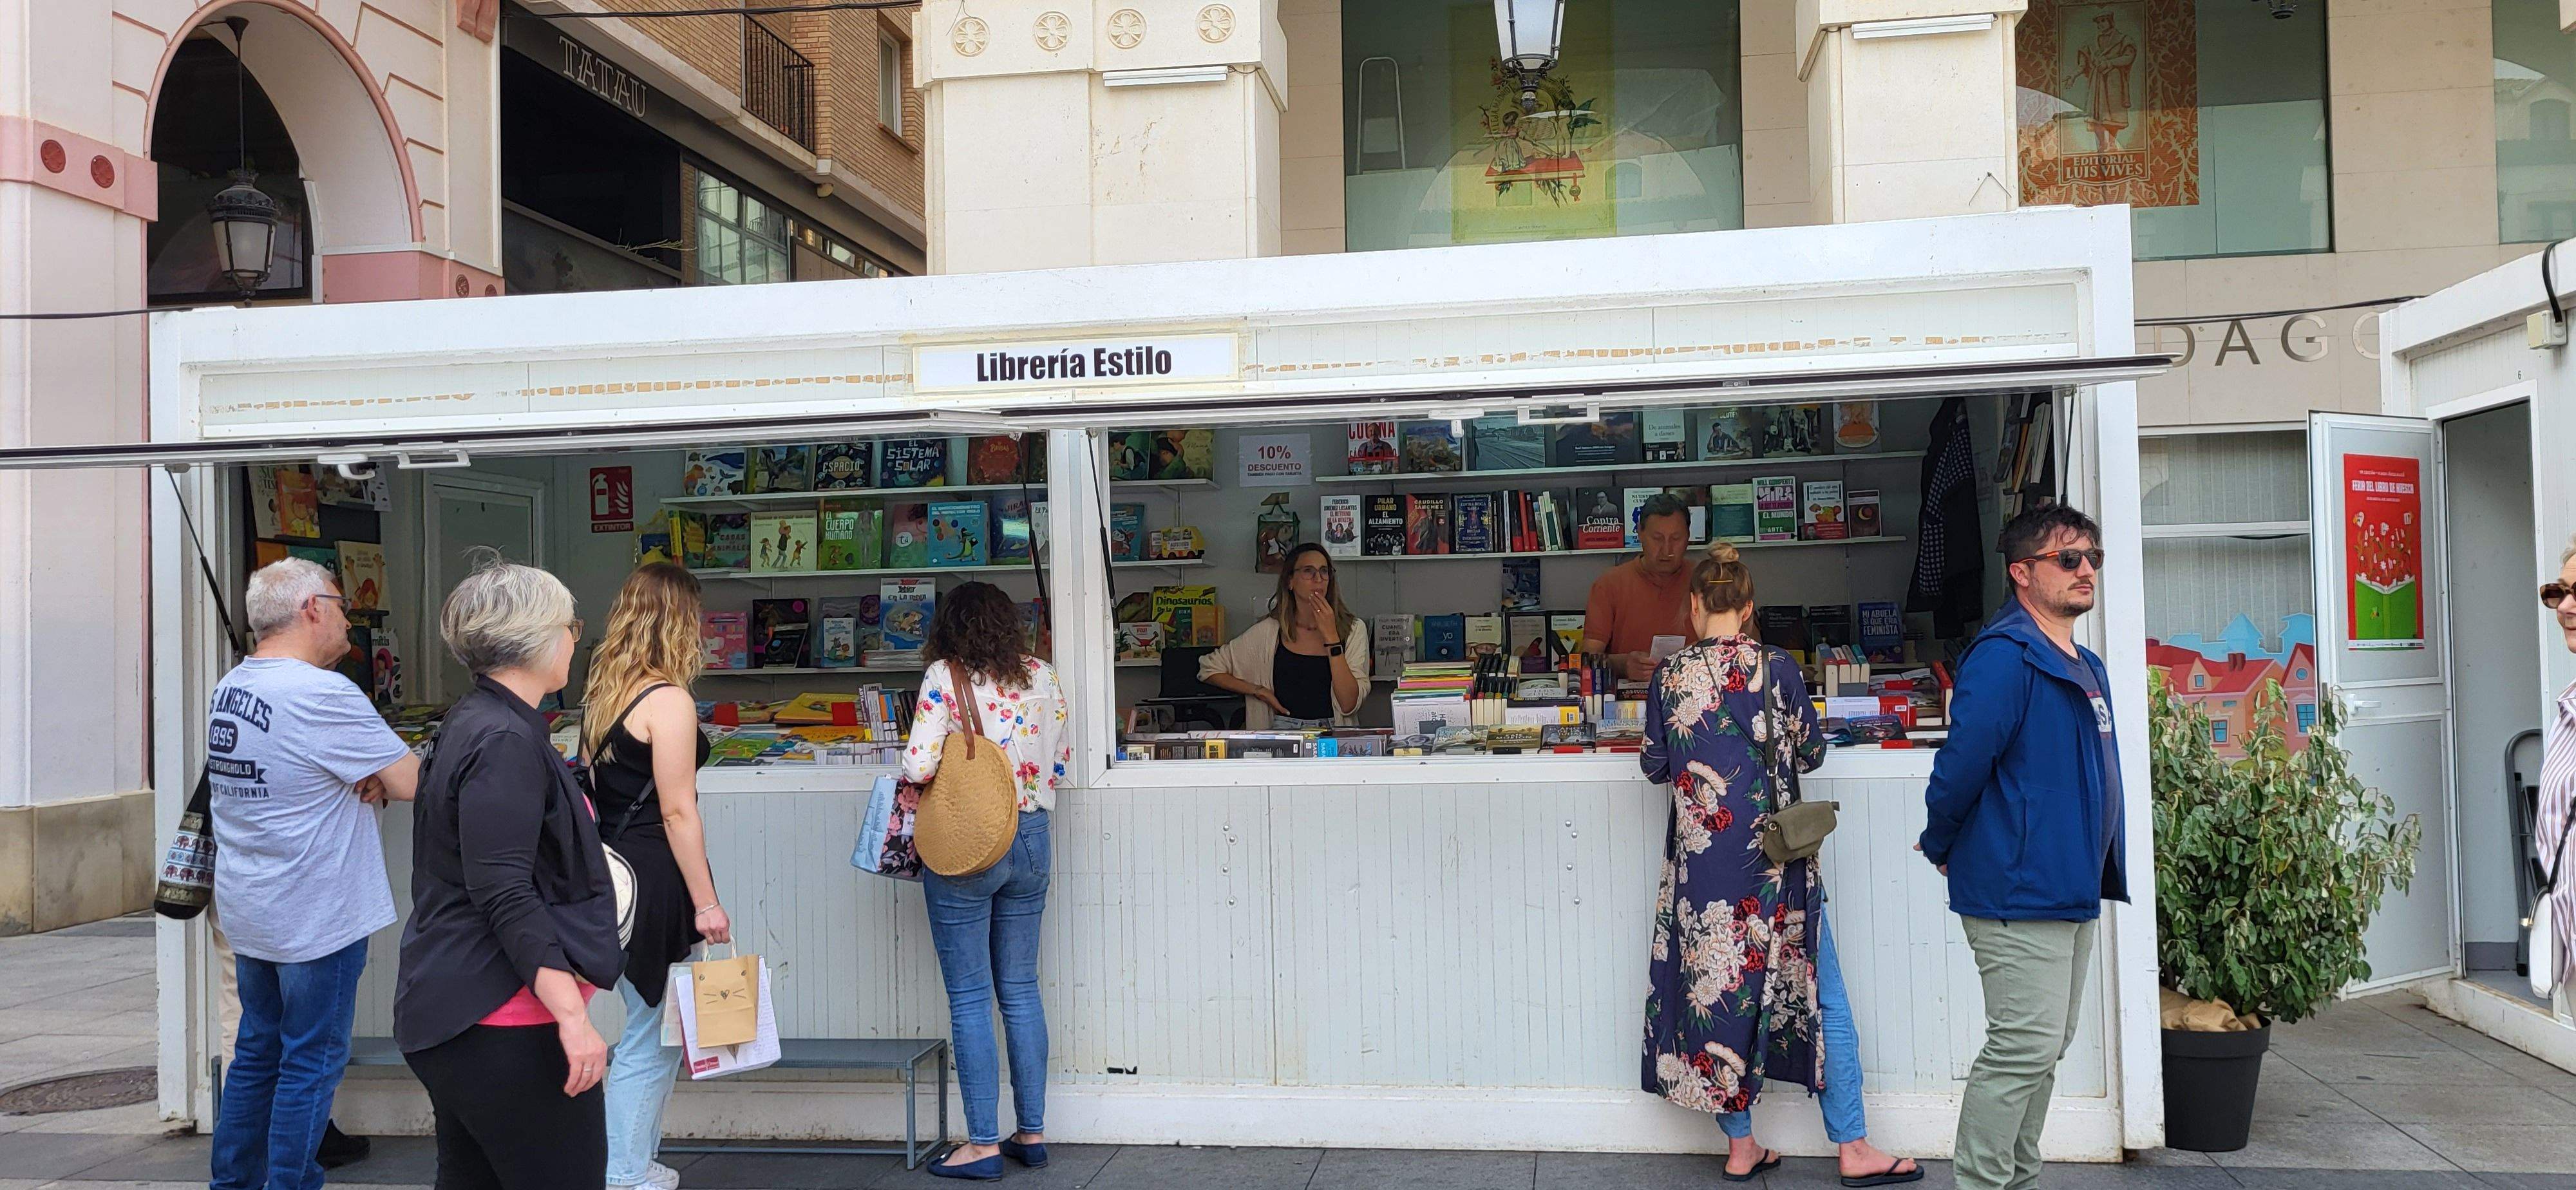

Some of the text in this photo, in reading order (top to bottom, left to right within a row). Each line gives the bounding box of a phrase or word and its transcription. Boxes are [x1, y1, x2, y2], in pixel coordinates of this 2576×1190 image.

[558, 35, 647, 118] TATAU
[2073, 155, 2136, 166] EDITORIAL
[2065, 164, 2143, 178] LUIS VIVES
[976, 346, 1172, 382] Librería Estilo
[2517, 370, 2522, 380] 6
[886, 447, 940, 459] SISTEMA
[1258, 445, 1291, 460] 10%
[822, 461, 860, 473] ESPACIO
[894, 458, 931, 472] SOLAR
[1247, 463, 1302, 471] DESCUENTO
[825, 518, 854, 531] CUERPO
[1586, 516, 1619, 525] Contra
[594, 524, 630, 532] EXTINTOR
[1583, 524, 1620, 533] Corriente
[825, 530, 853, 540] HUMANO
[1155, 597, 1214, 606] Dinosaurios
[1863, 625, 1899, 635] FEMINISTA
[216, 686, 272, 733] ANGELES
[210, 724, 235, 748] 1895
[220, 784, 270, 799] CALIFORNIA
